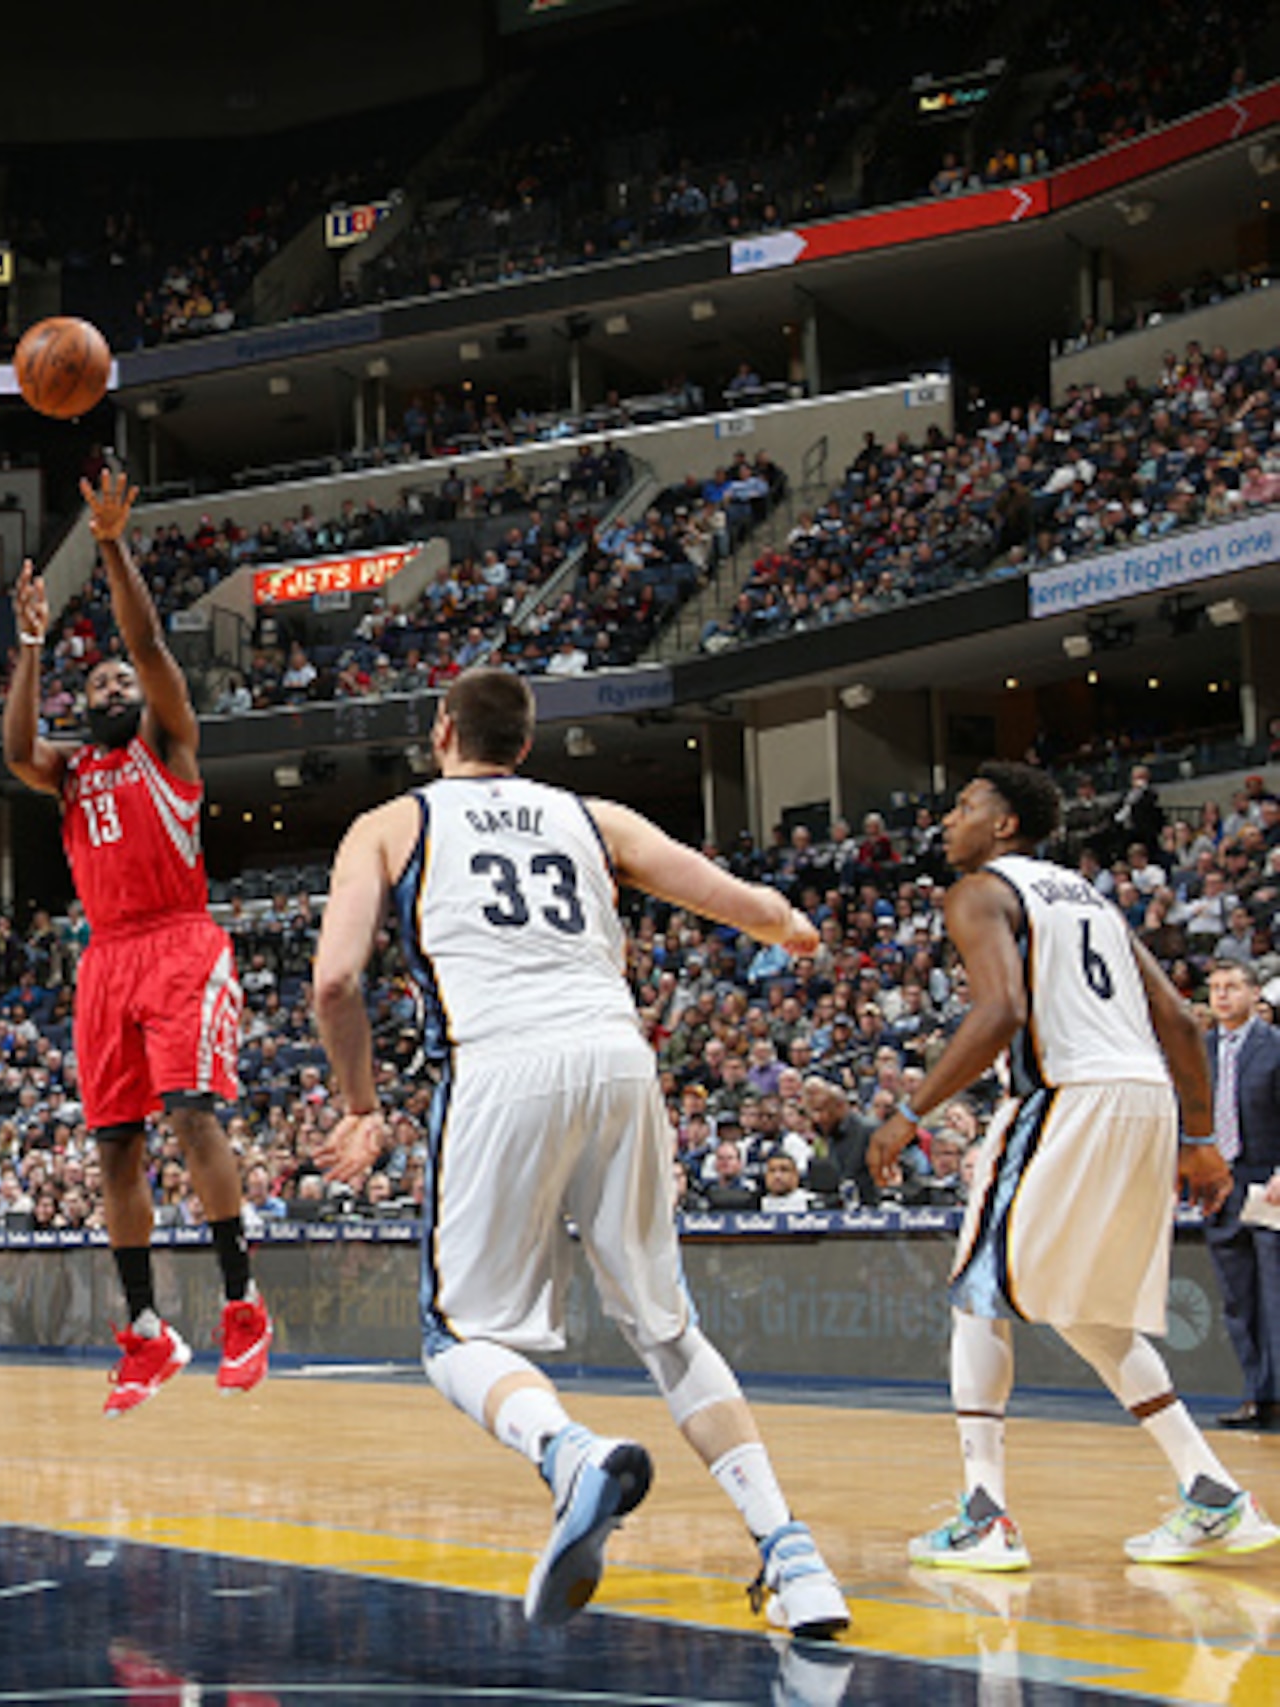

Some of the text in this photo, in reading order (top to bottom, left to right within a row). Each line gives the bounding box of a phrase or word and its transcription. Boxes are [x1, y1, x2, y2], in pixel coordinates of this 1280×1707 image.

[1122, 550, 1183, 586] flight
[1189, 544, 1220, 568] on
[1227, 531, 1272, 557] one
[80, 792, 122, 848] 13
[470, 853, 587, 935] 33
[1078, 918, 1114, 1000] 6
